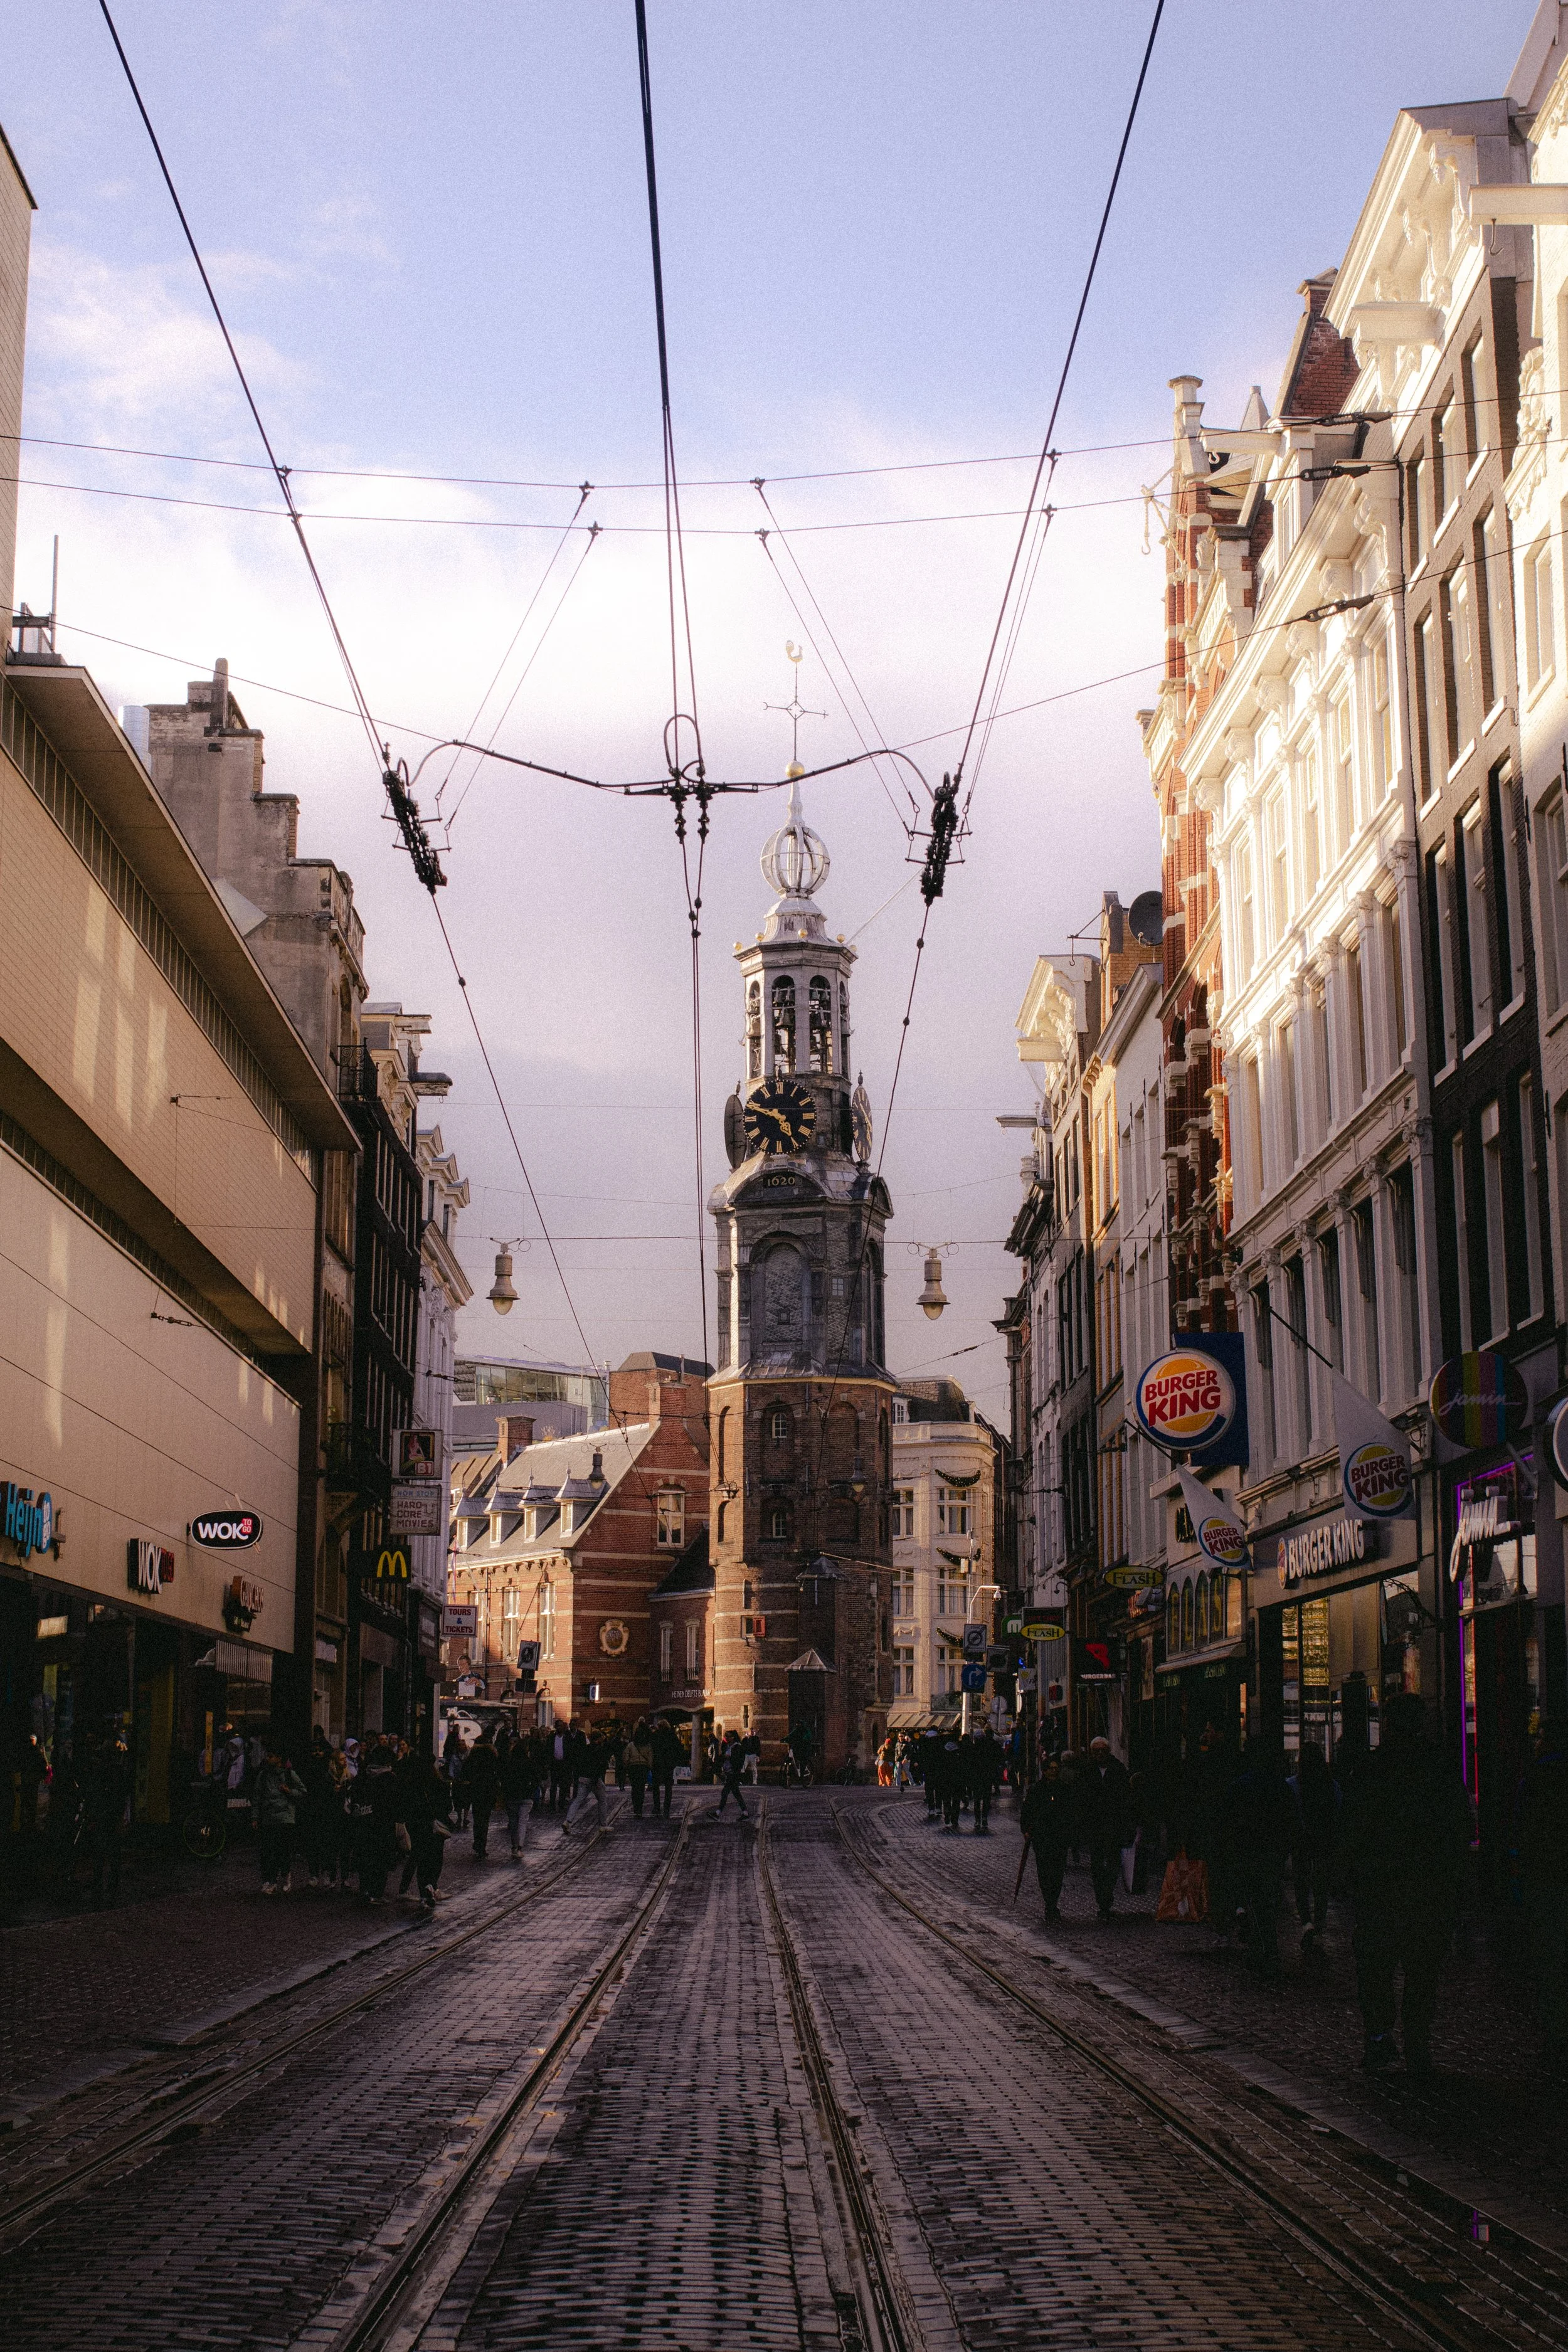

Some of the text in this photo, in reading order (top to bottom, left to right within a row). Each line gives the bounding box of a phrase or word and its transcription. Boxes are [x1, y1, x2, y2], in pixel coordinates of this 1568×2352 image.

[768, 1175, 795, 1186] 1620
[1145, 1370, 1217, 1402] BURGER
[1148, 1386, 1221, 1427] KING
[1351, 1455, 1405, 1483] BURGER
[1355, 1468, 1409, 1502] KING
[397, 1501, 422, 1509] HARD
[5, 1481, 43, 1558] Heijn
[396, 1520, 434, 1528] MOVIES
[198, 1522, 249, 1540] WOK
[1204, 1528, 1239, 1542] BURGER
[1209, 1536, 1244, 1555] KING
[1288, 1519, 1365, 1580] BURGER KING
[138, 1538, 163, 1594] WOK
[1113, 1572, 1156, 1585] FLASH
[1027, 1628, 1060, 1638] FLASH
